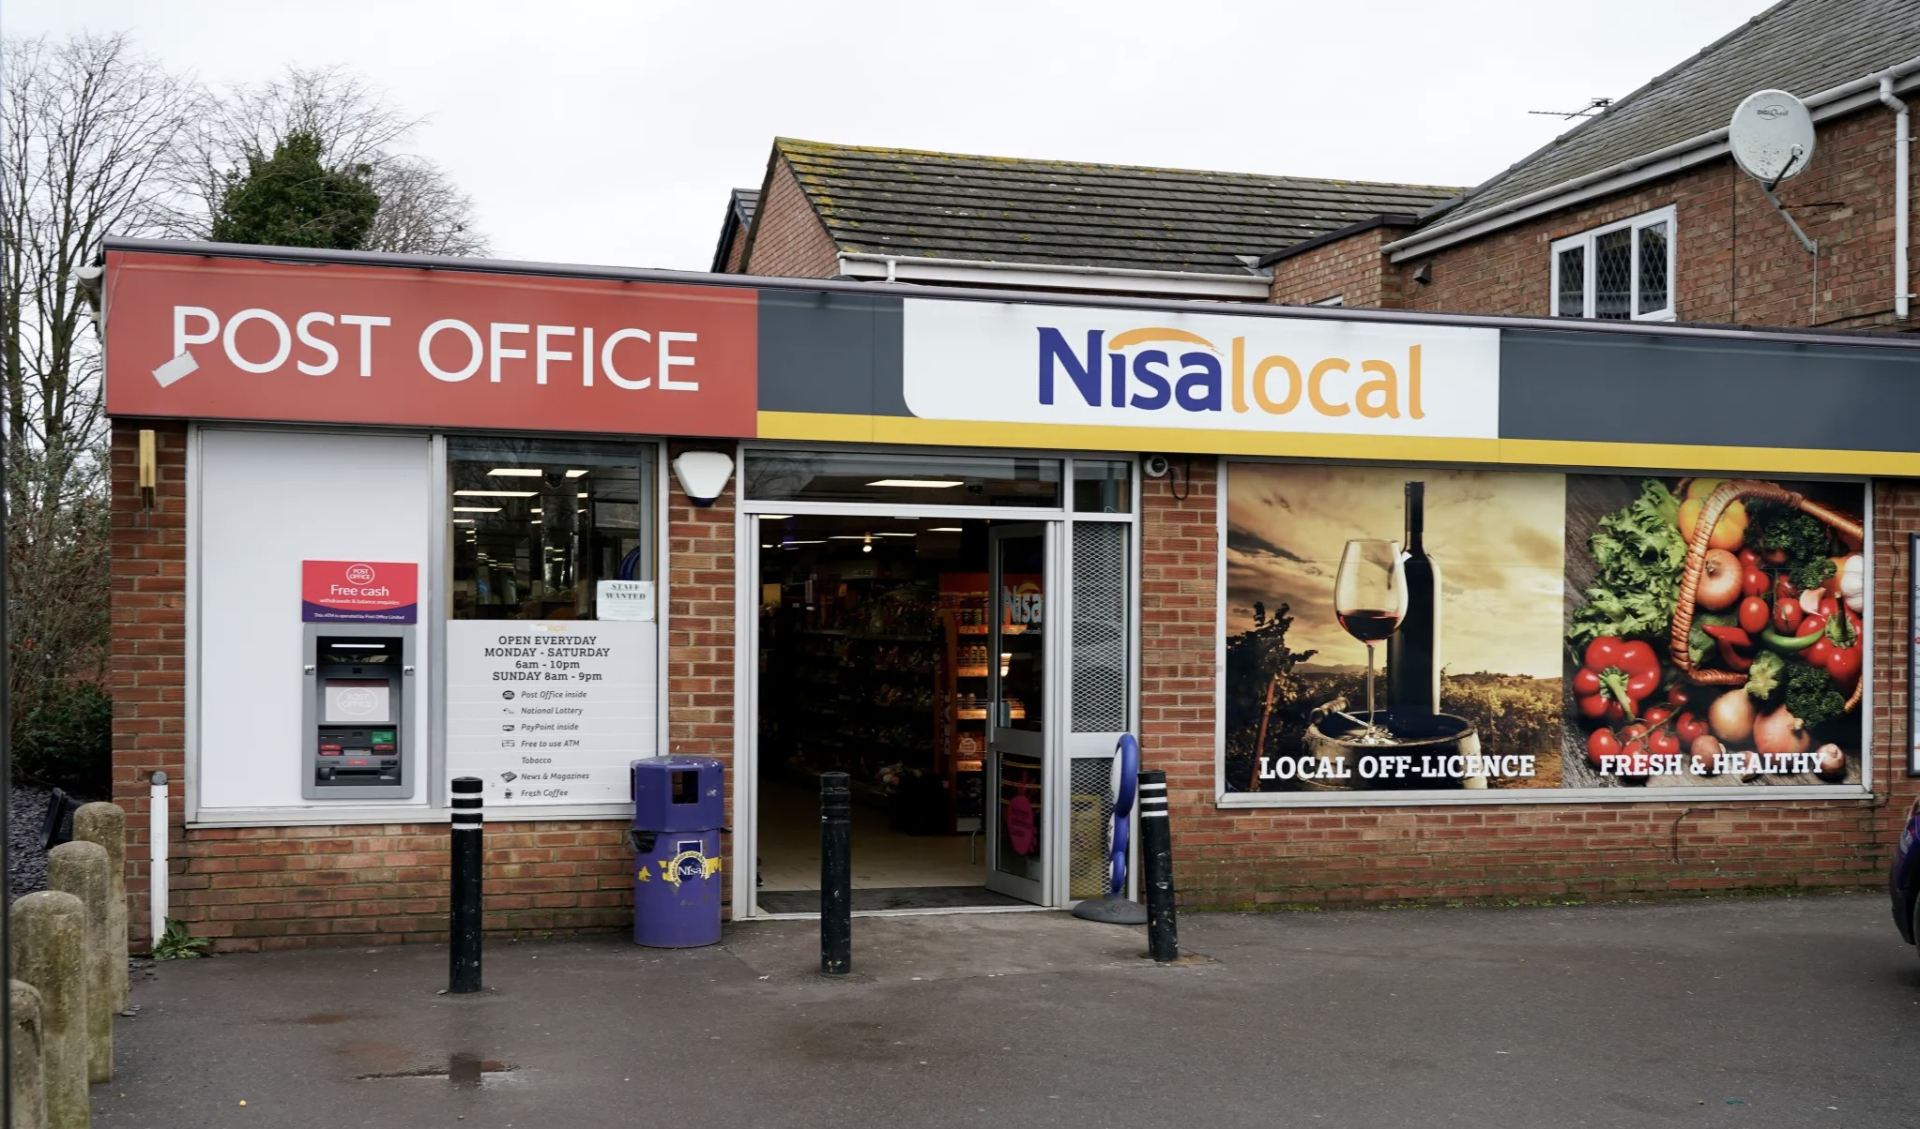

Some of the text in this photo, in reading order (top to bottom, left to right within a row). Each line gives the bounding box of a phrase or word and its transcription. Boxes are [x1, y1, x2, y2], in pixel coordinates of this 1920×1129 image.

[172, 305, 699, 391] POST OFFICE
[330, 584, 390, 597] Free cash
[606, 592, 646, 600] WANTED
[1003, 585, 1042, 624] Nisa
[498, 636, 597, 645] OPEN EVERYDAY
[484, 648, 537, 657] MONDAY
[547, 648, 610, 657] SATURDAY
[515, 660, 539, 669] 6am
[550, 660, 580, 670] 10pm
[492, 671, 542, 681] SUNDAY
[544, 672, 568, 681] 8am
[578, 672, 602, 682] 9pm
[520, 690, 538, 699] Post
[539, 690, 563, 700] Office
[565, 690, 587, 699] inside
[520, 707, 583, 716] National Lottery
[520, 723, 579, 732] PayPoint inside
[563, 739, 580, 747] ATM
[1259, 754, 1536, 780] LOCAL OFF-LICENCE
[1600, 752, 1827, 777] FRESH & HEALTHY
[542, 772, 548, 780] &
[549, 772, 590, 781] Magazines
[520, 788, 569, 798] Fresh Coffee
[678, 866, 702, 875] Nisa
